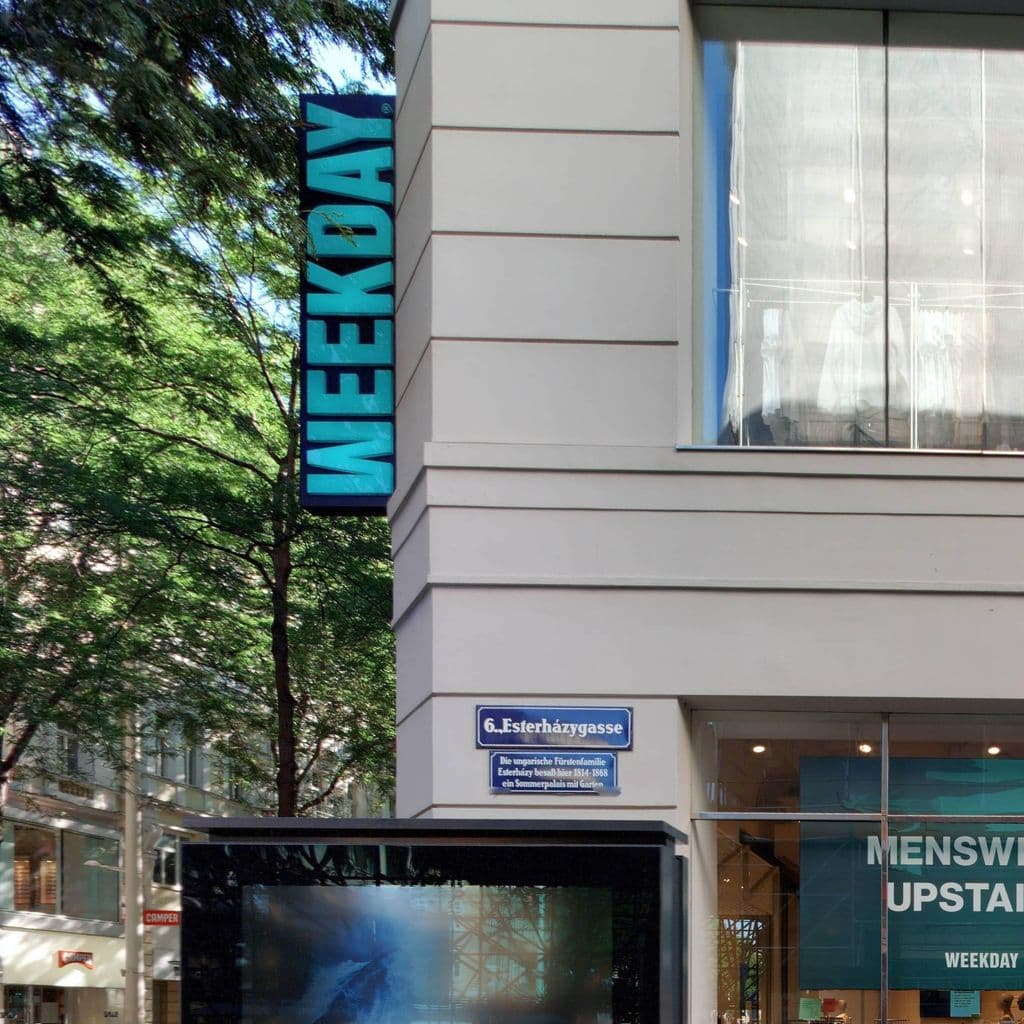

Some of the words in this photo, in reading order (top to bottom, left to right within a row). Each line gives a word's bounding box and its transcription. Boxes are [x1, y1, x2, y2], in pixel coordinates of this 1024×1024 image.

[306, 102, 394, 495] WEEKDAY
[499, 756, 512, 765] Die
[513, 756, 553, 767] ungarische
[554, 756, 607, 766] Fürstenfamilie
[497, 767, 533, 778] Esterházy
[557, 768, 573, 777] hier
[502, 779, 515, 788] ein
[515, 778, 566, 790] Sommerpalais
[566, 779, 579, 789] mit
[145, 912, 179, 923] CAMPER
[945, 952, 1019, 969] WEEKDAY
